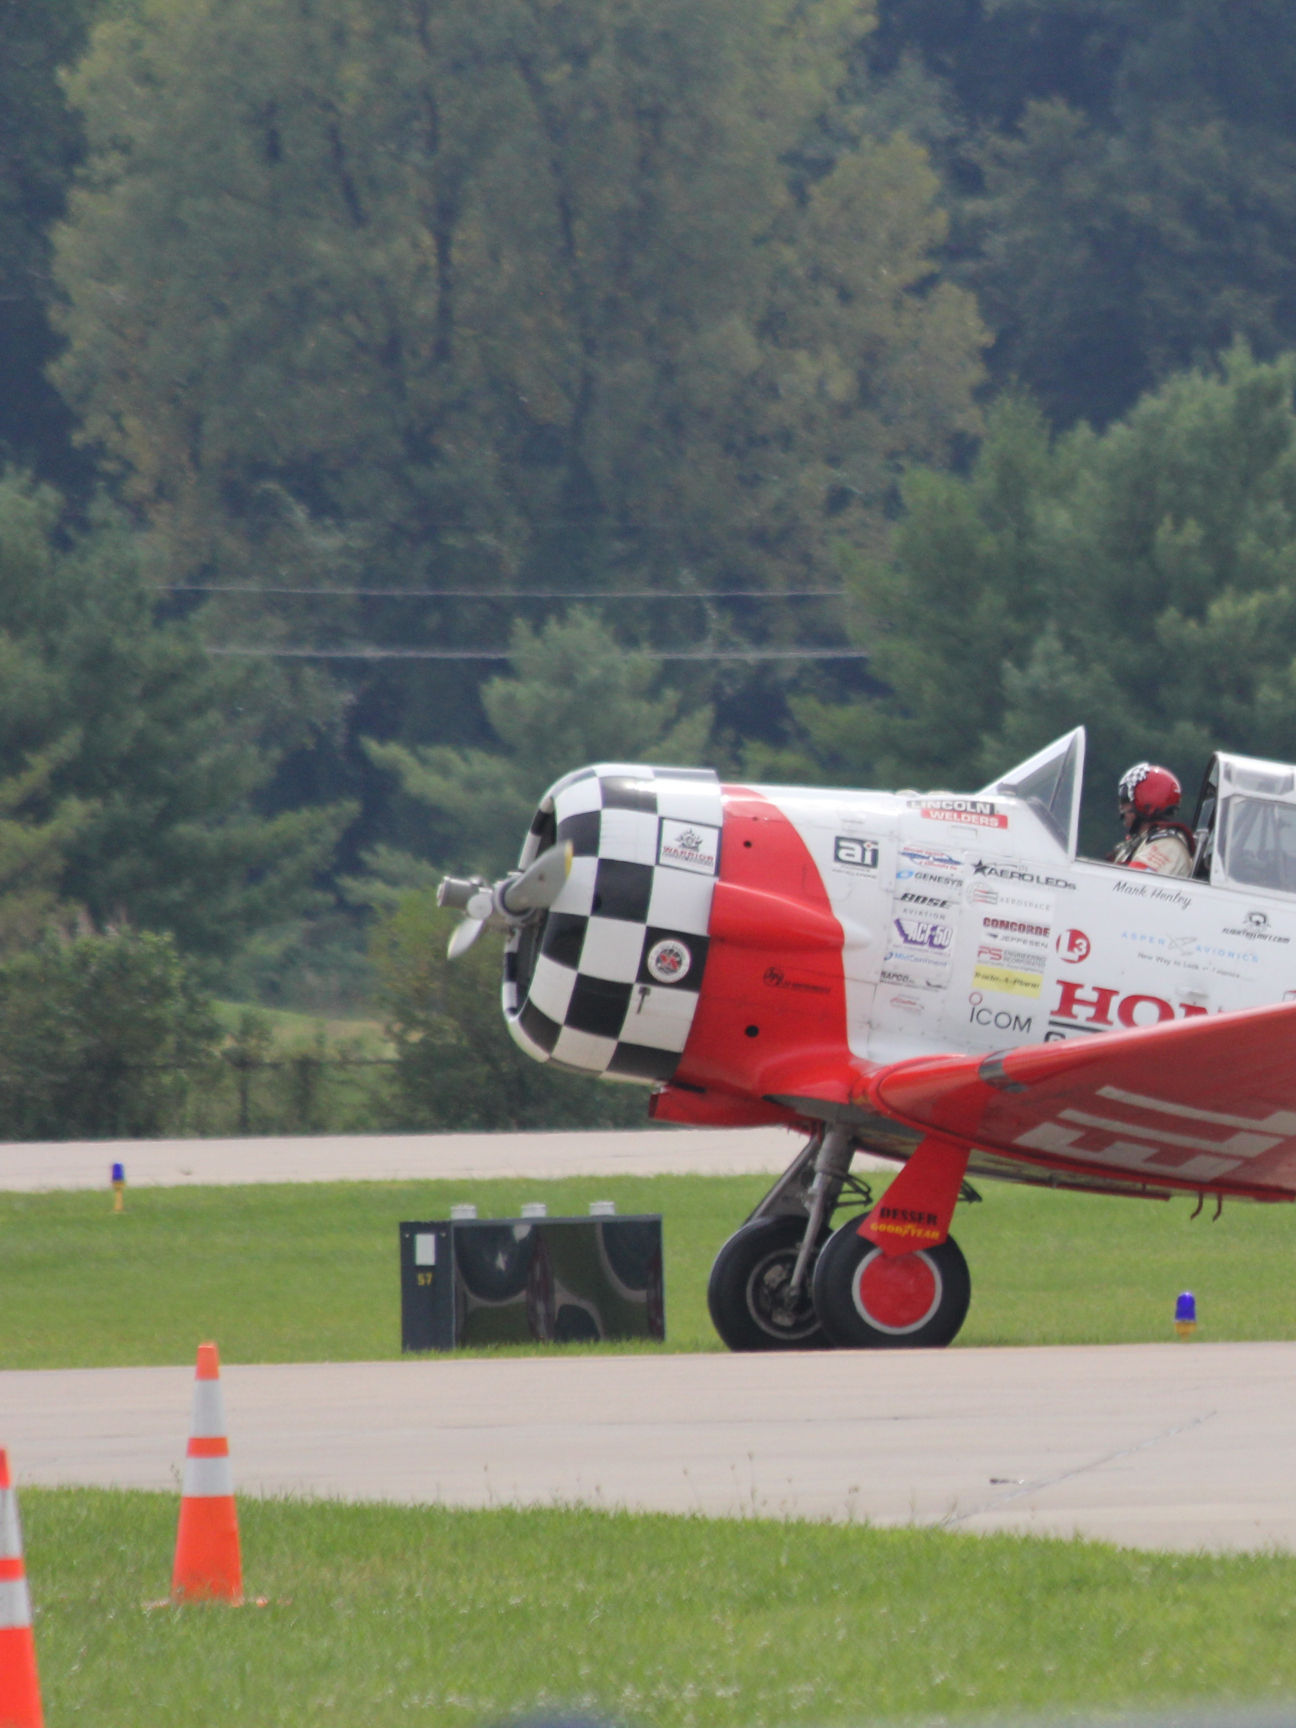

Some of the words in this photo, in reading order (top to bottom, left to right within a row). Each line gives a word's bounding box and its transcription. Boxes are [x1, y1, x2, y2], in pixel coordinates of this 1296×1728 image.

[909, 800, 991, 815] LINCOLN
[929, 809, 999, 827] WELDERS
[663, 846, 714, 862] WARRIOR
[914, 871, 964, 888] GENESYS
[900, 892, 951, 909] BOSE
[1112, 880, 1147, 898] Mark
[1150, 887, 1192, 911] Henley
[982, 916, 1051, 937] CONCORDE
[1122, 931, 1165, 946] ASPEN
[1195, 945, 1260, 963] AVIONICS
[879, 1206, 938, 1227] DESSER
